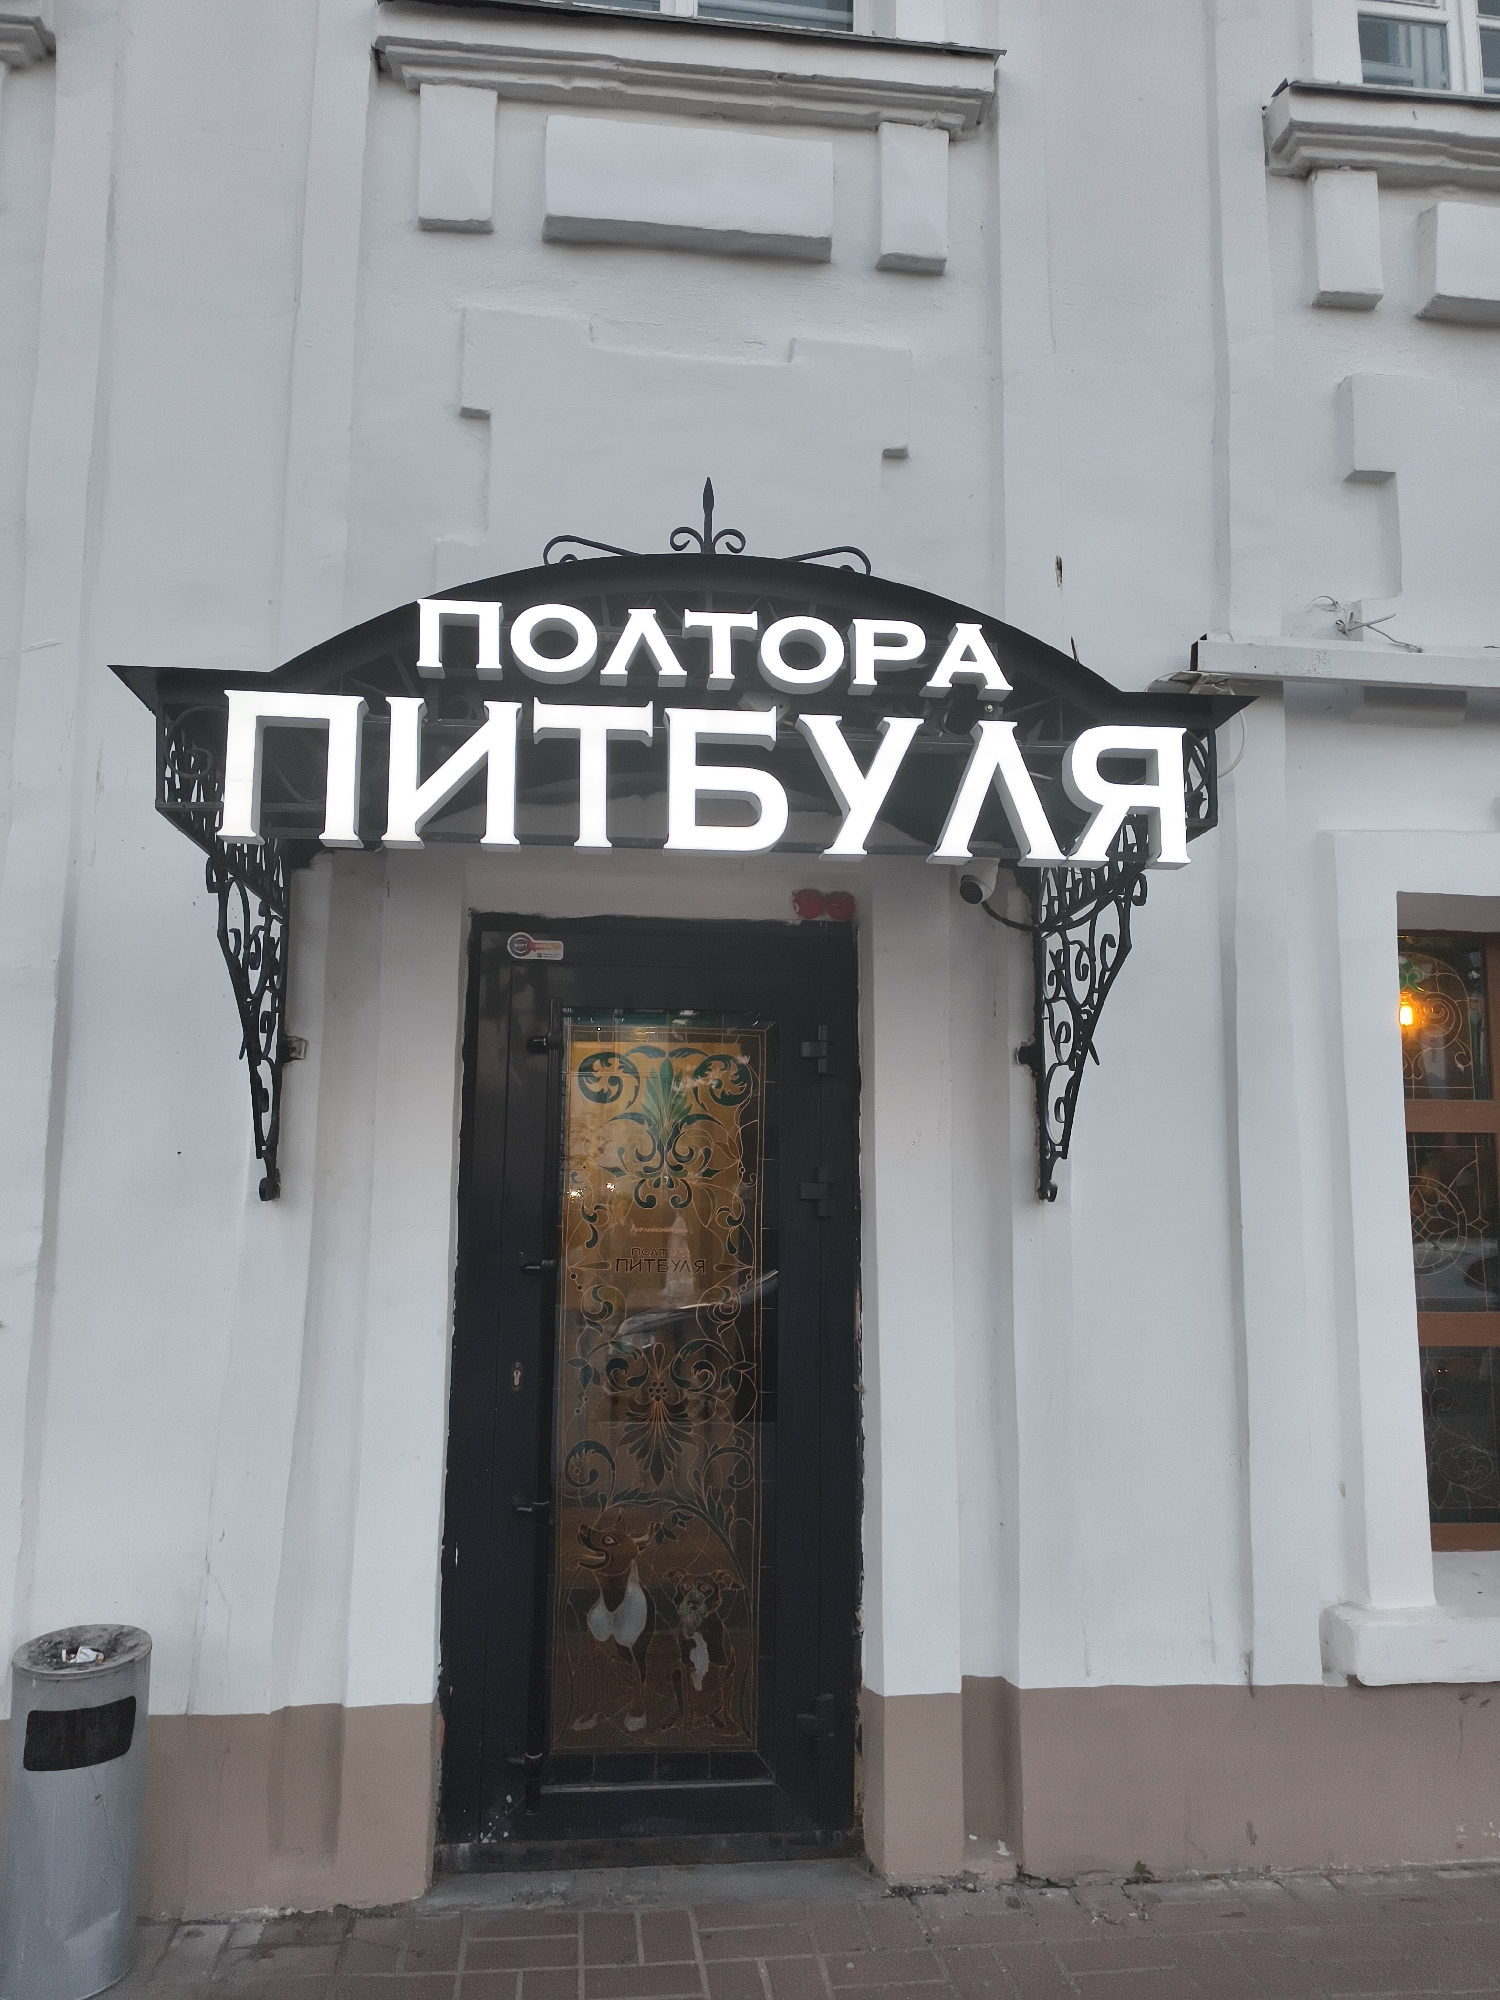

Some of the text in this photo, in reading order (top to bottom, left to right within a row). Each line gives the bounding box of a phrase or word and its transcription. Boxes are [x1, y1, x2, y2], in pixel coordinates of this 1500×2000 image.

[417, 598, 1014, 697] ПОЛТОРА
[217, 689, 1192, 867] ПИТБУЛЯ
[615, 1257, 706, 1275] ПИТБУЛЯ
